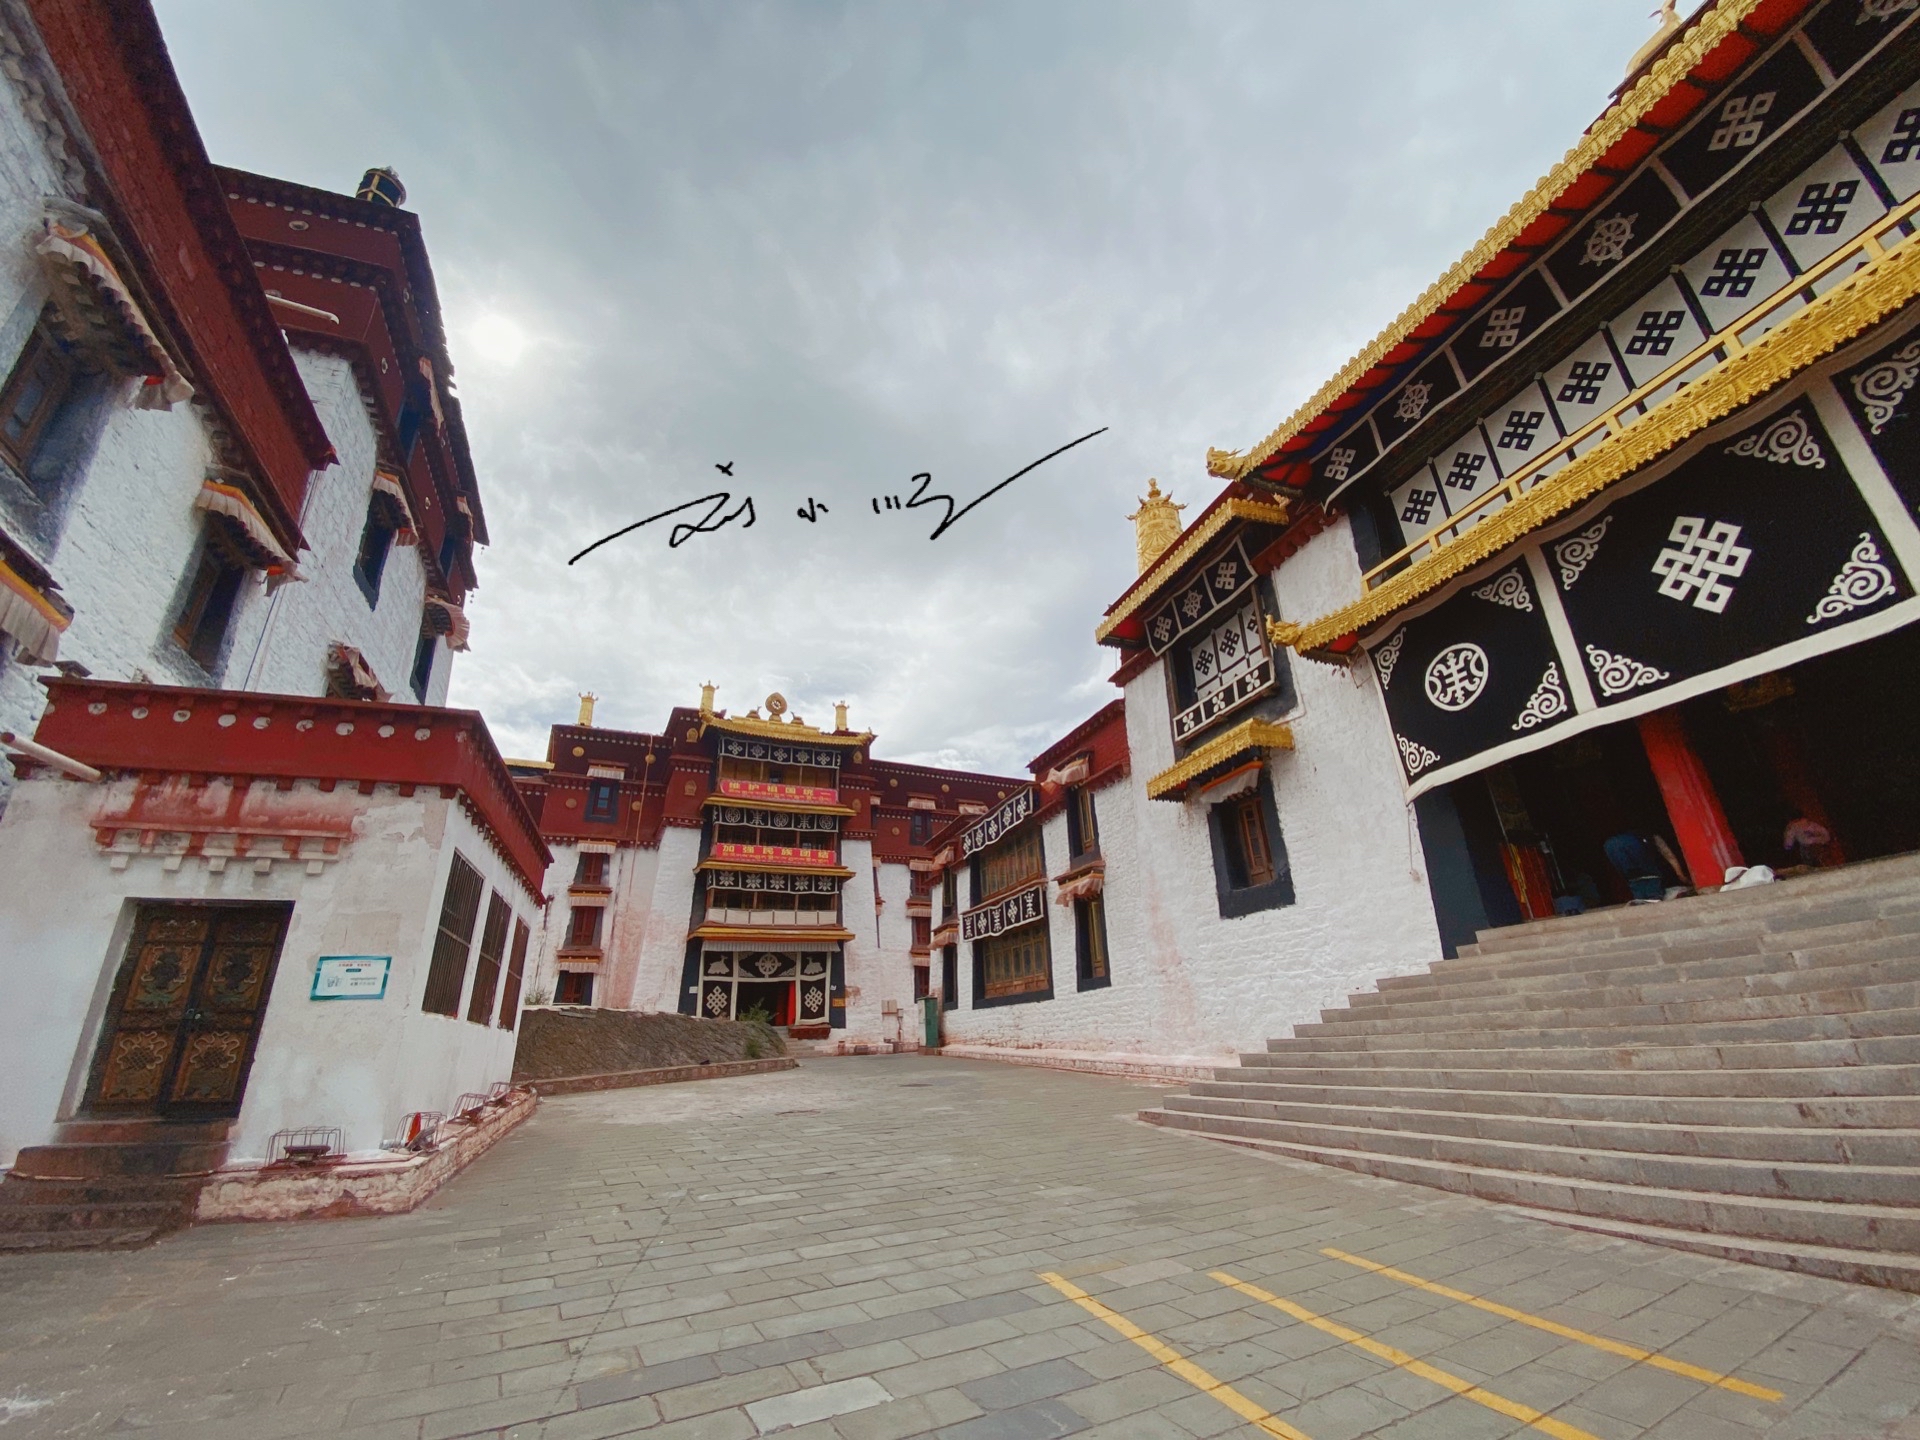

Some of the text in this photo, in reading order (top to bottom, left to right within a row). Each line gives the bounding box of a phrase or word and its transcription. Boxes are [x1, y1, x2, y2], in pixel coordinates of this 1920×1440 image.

[728, 781, 832, 797] 维护祖国统一
[722, 844, 830, 859] 加强民族团结
